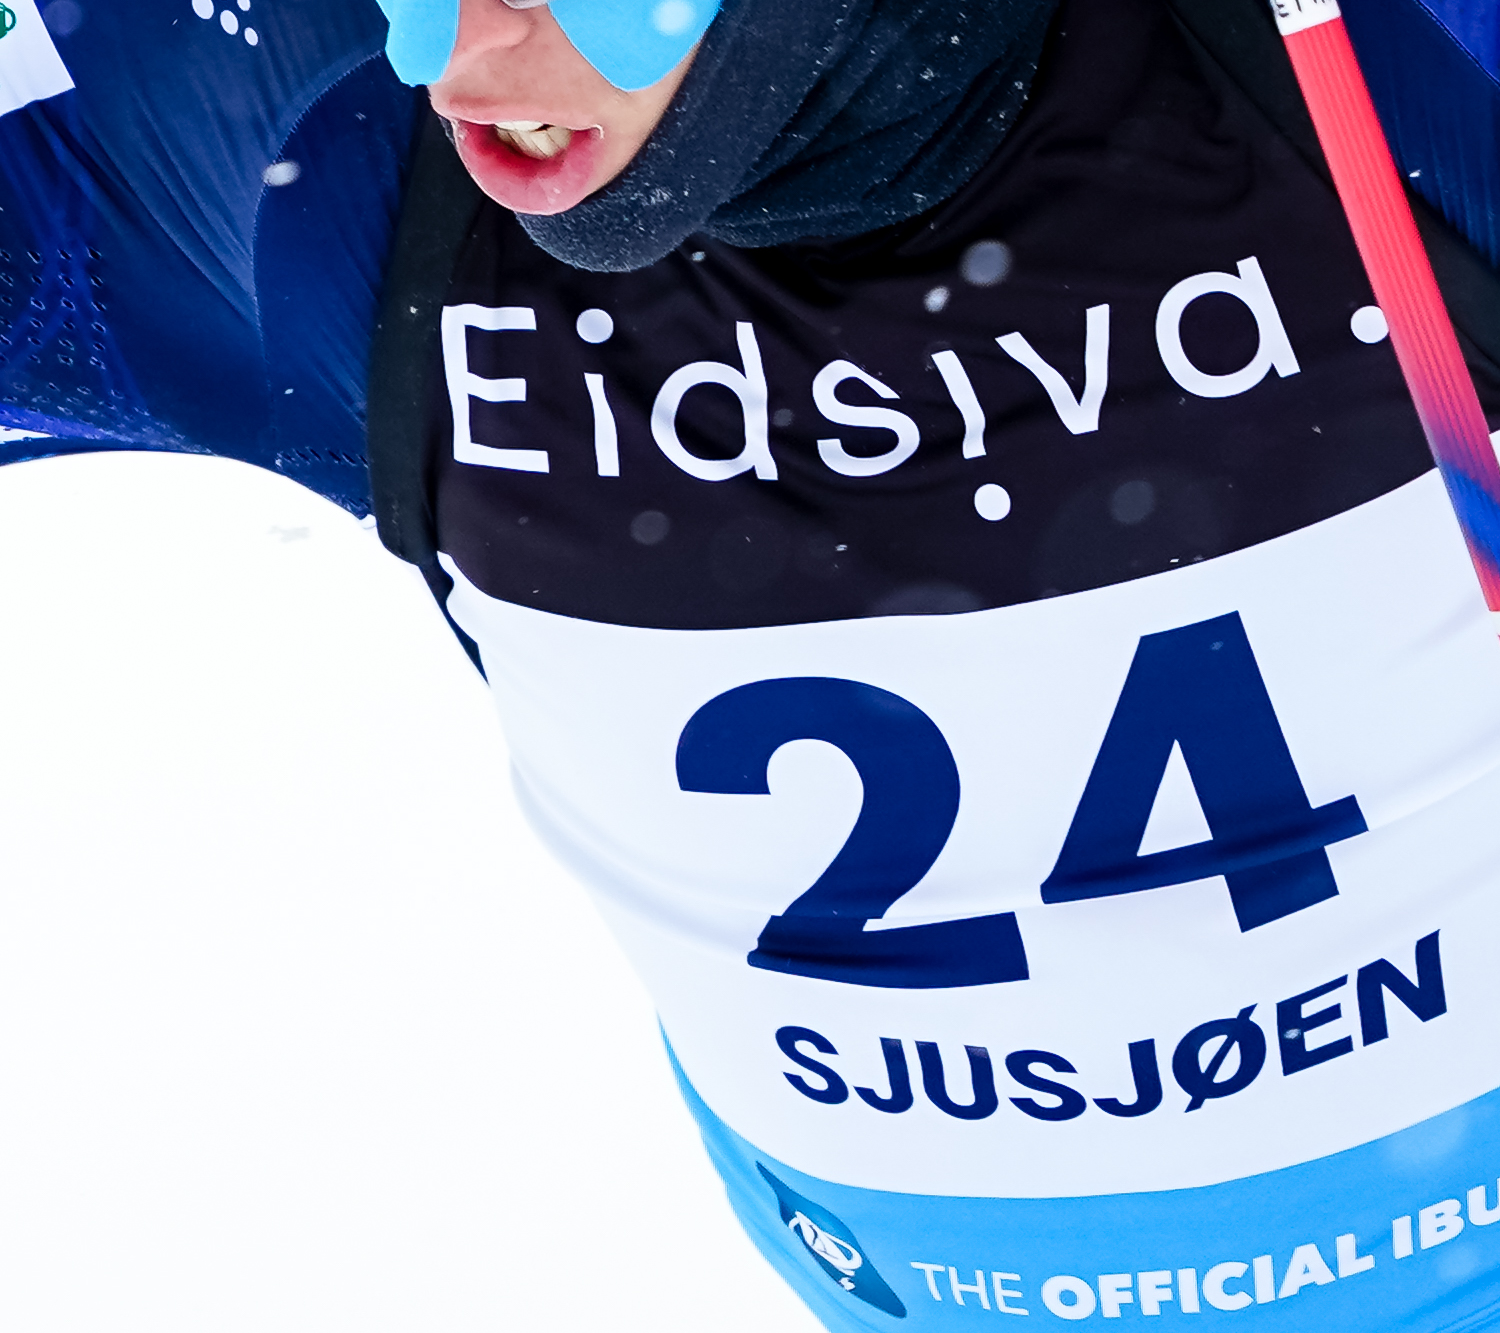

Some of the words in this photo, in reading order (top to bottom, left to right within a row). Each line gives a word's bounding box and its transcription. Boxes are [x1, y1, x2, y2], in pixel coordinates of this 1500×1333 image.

[675, 610, 1369, 990] 24
[775, 928, 1448, 1122] SJUSJØEN
[910, 1261, 1029, 1316] THE
[1042, 1233, 1376, 1320] OFFICIAL
